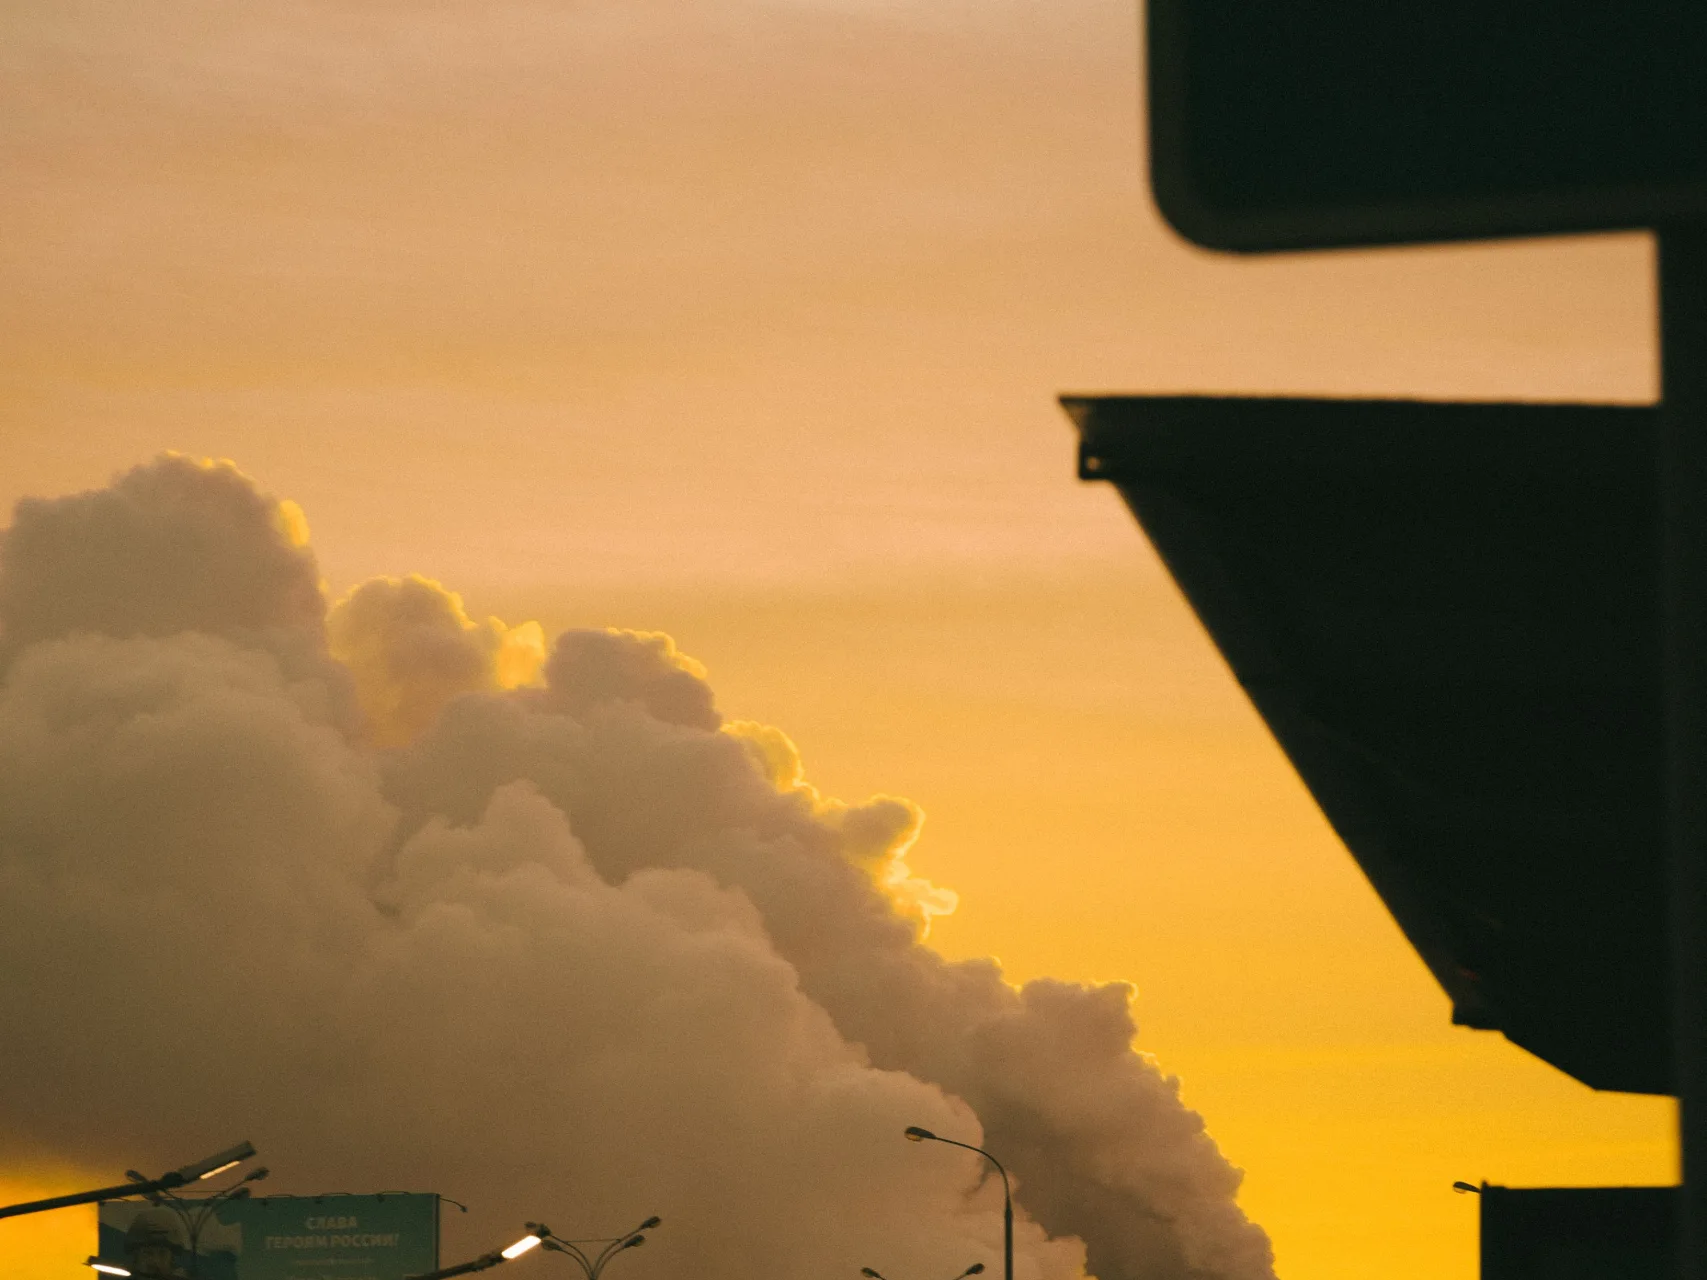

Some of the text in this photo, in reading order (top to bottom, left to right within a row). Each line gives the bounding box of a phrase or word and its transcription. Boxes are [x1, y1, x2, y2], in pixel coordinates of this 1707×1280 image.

[305, 1216, 358, 1230] СЛАВА
[264, 1233, 400, 1249] ГЕРОЯМ РОССИИ!
